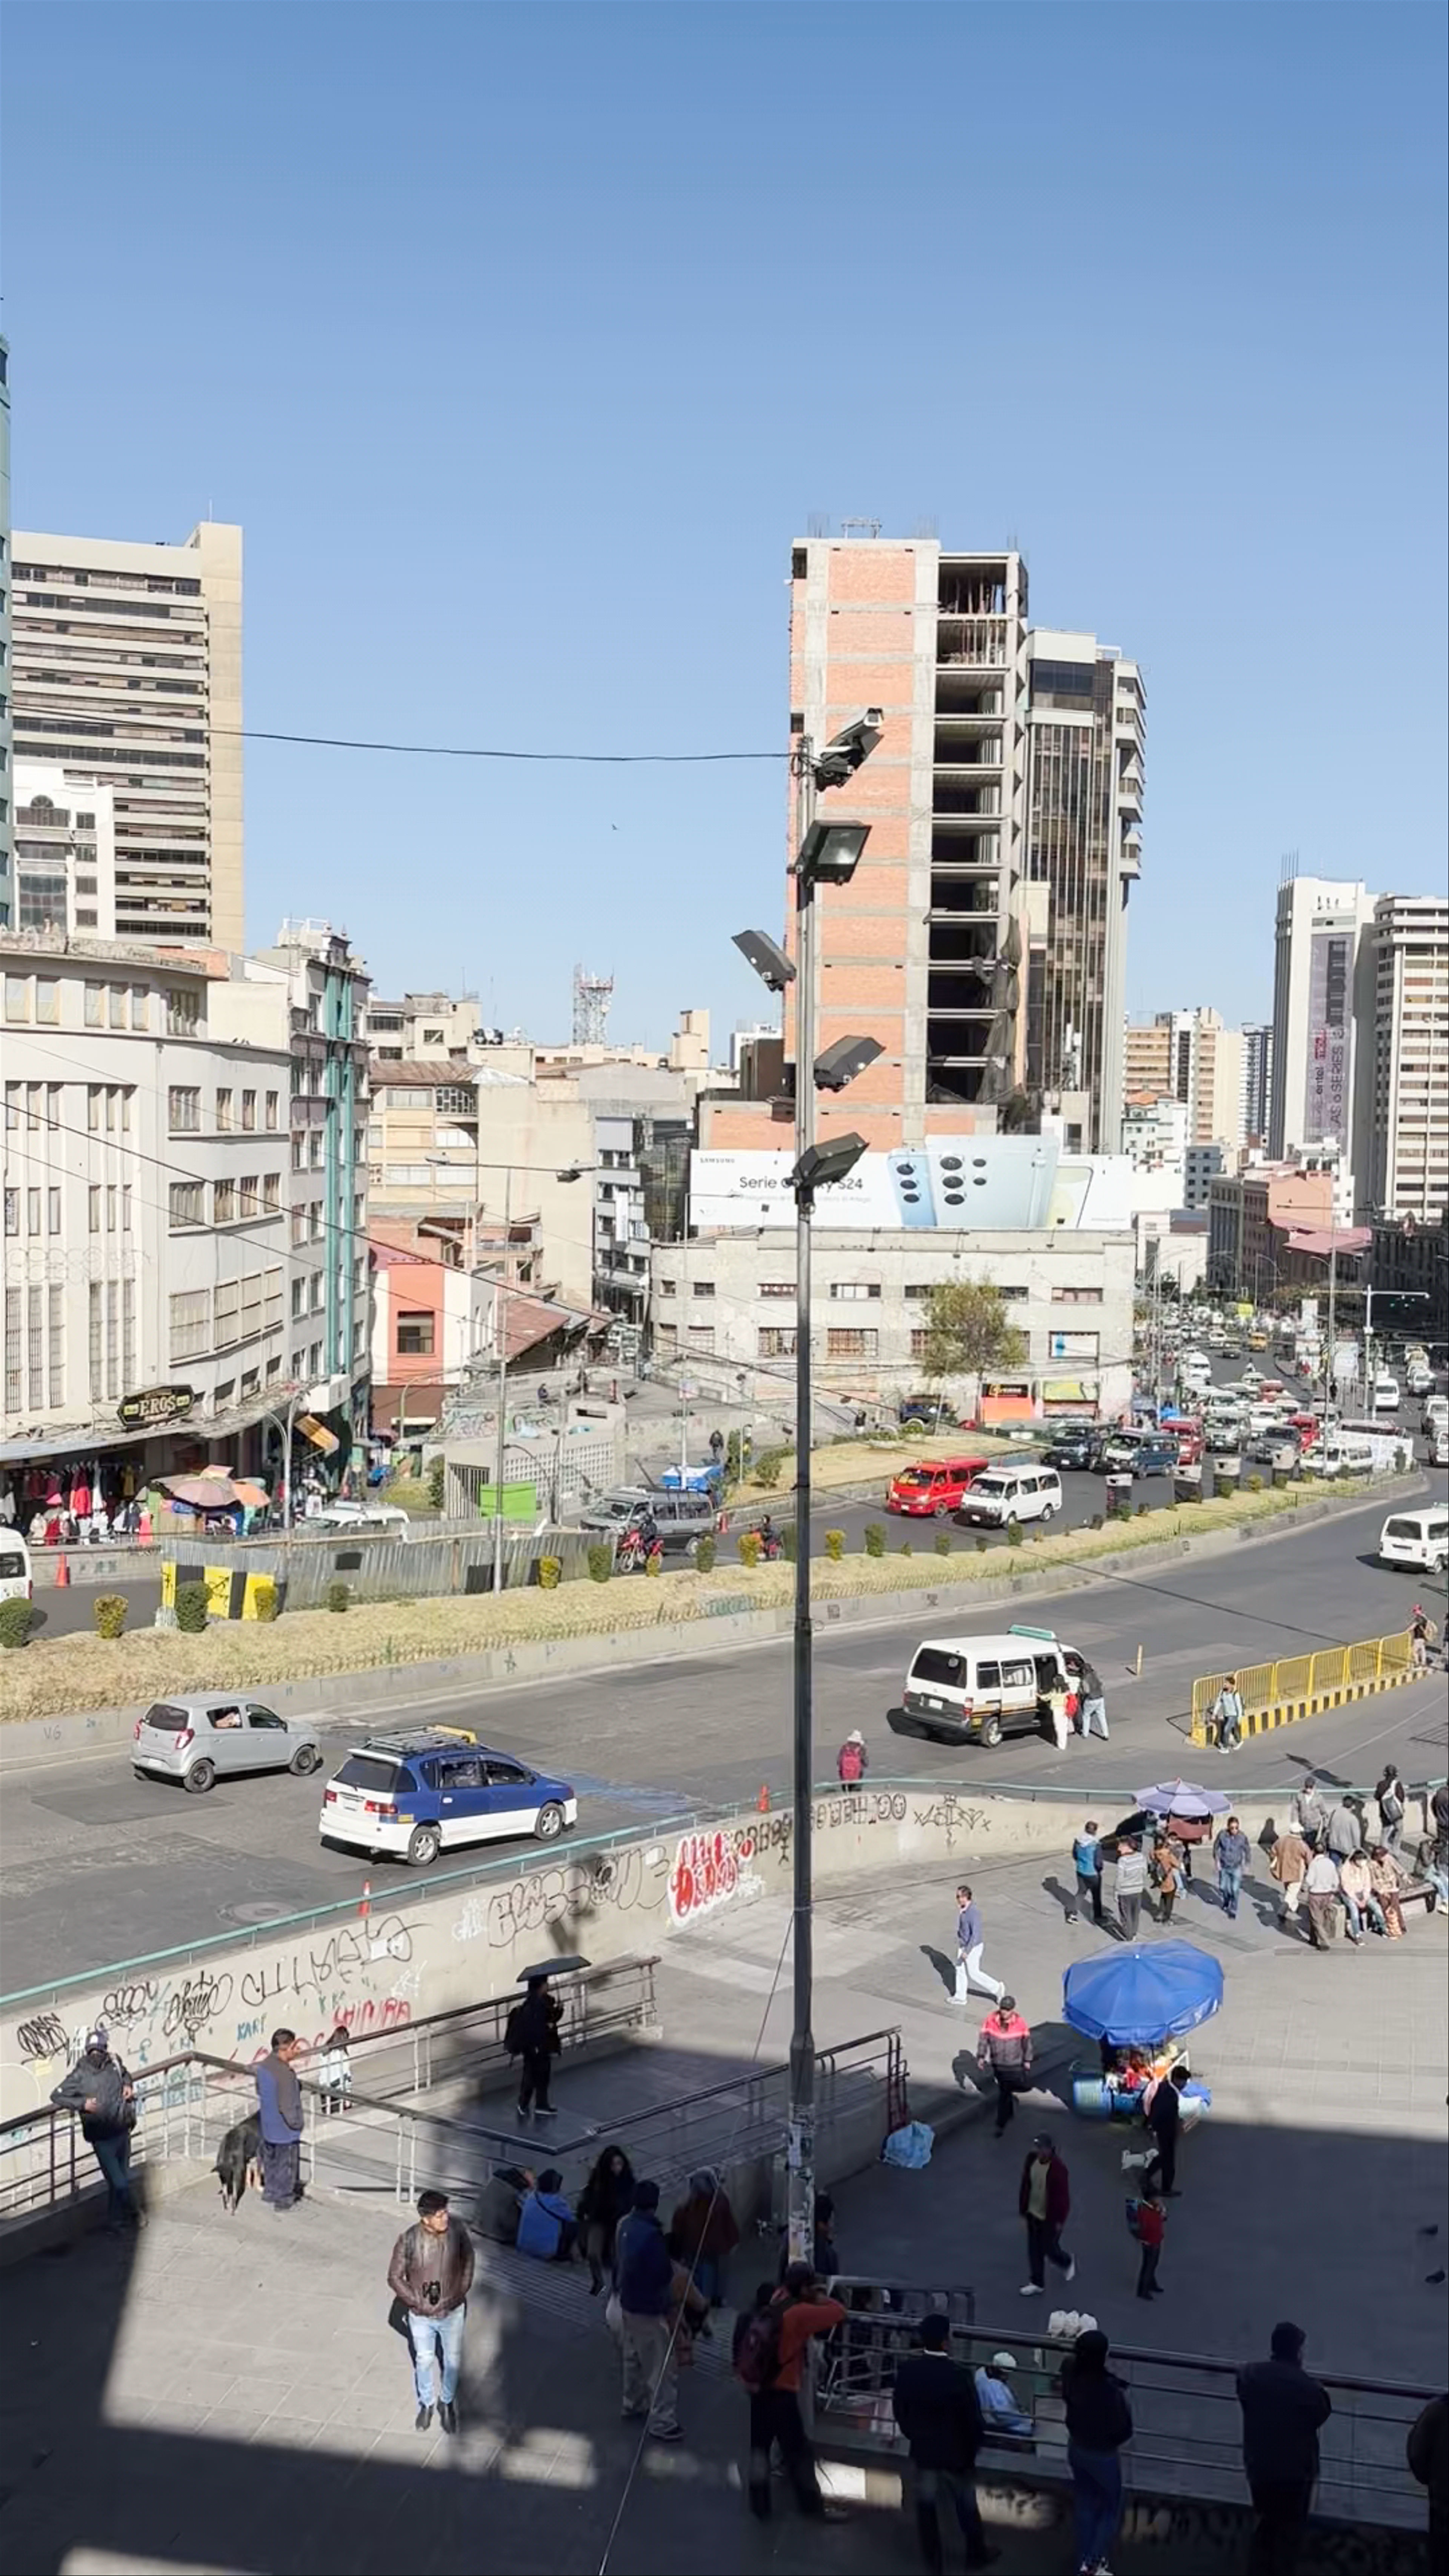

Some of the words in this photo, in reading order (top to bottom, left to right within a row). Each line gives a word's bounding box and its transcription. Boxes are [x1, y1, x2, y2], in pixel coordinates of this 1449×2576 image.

[740, 1176, 777, 1189] Serie
[838, 1178, 863, 1190] S24
[139, 1395, 176, 1416] EROS
